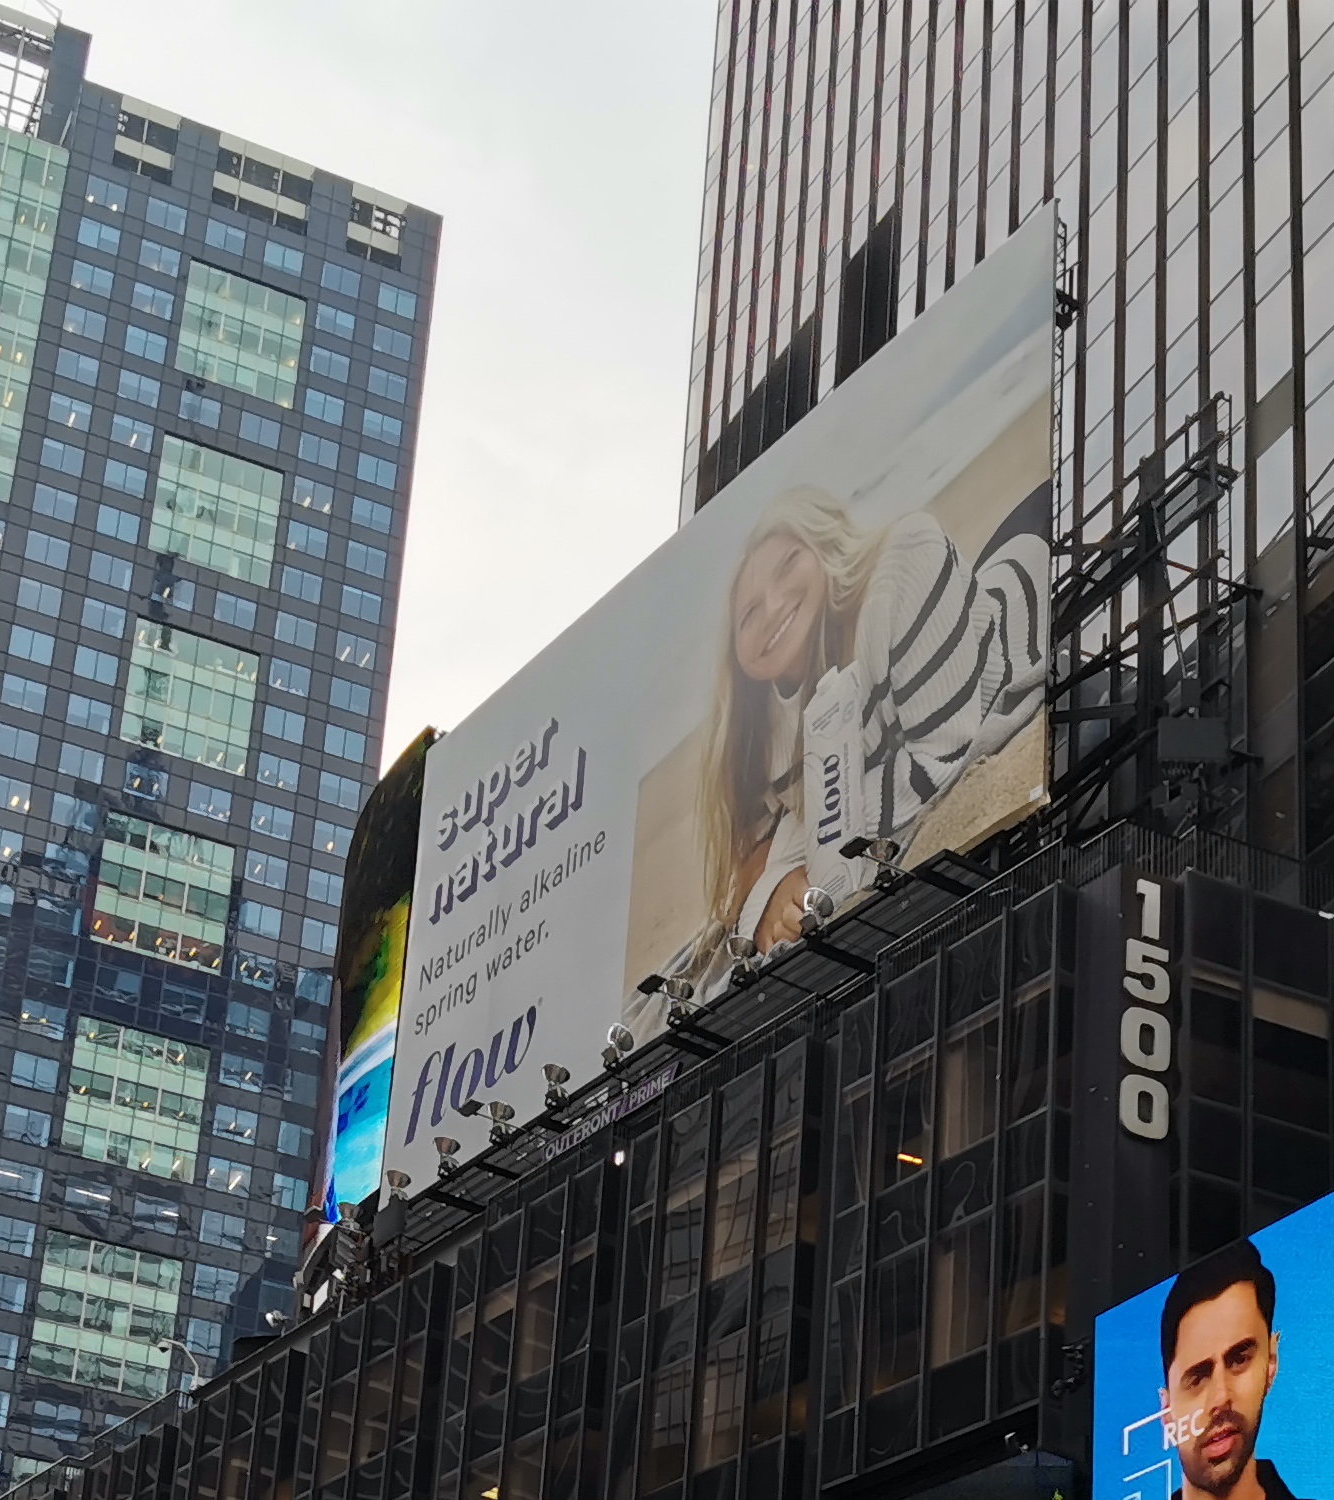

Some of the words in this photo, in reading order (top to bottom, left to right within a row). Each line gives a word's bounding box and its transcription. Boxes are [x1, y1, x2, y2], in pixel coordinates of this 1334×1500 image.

[429, 746, 587, 925] natural
[436, 716, 559, 850] super
[817, 754, 842, 846] flow
[414, 966, 478, 1036] spring
[485, 919, 551, 983] water.
[417, 895, 512, 991] Naturally
[519, 829, 607, 907] alkaline
[404, 1004, 539, 1147] flow
[1119, 878, 1171, 1140] 1500
[1163, 1408, 1206, 1451] REC
